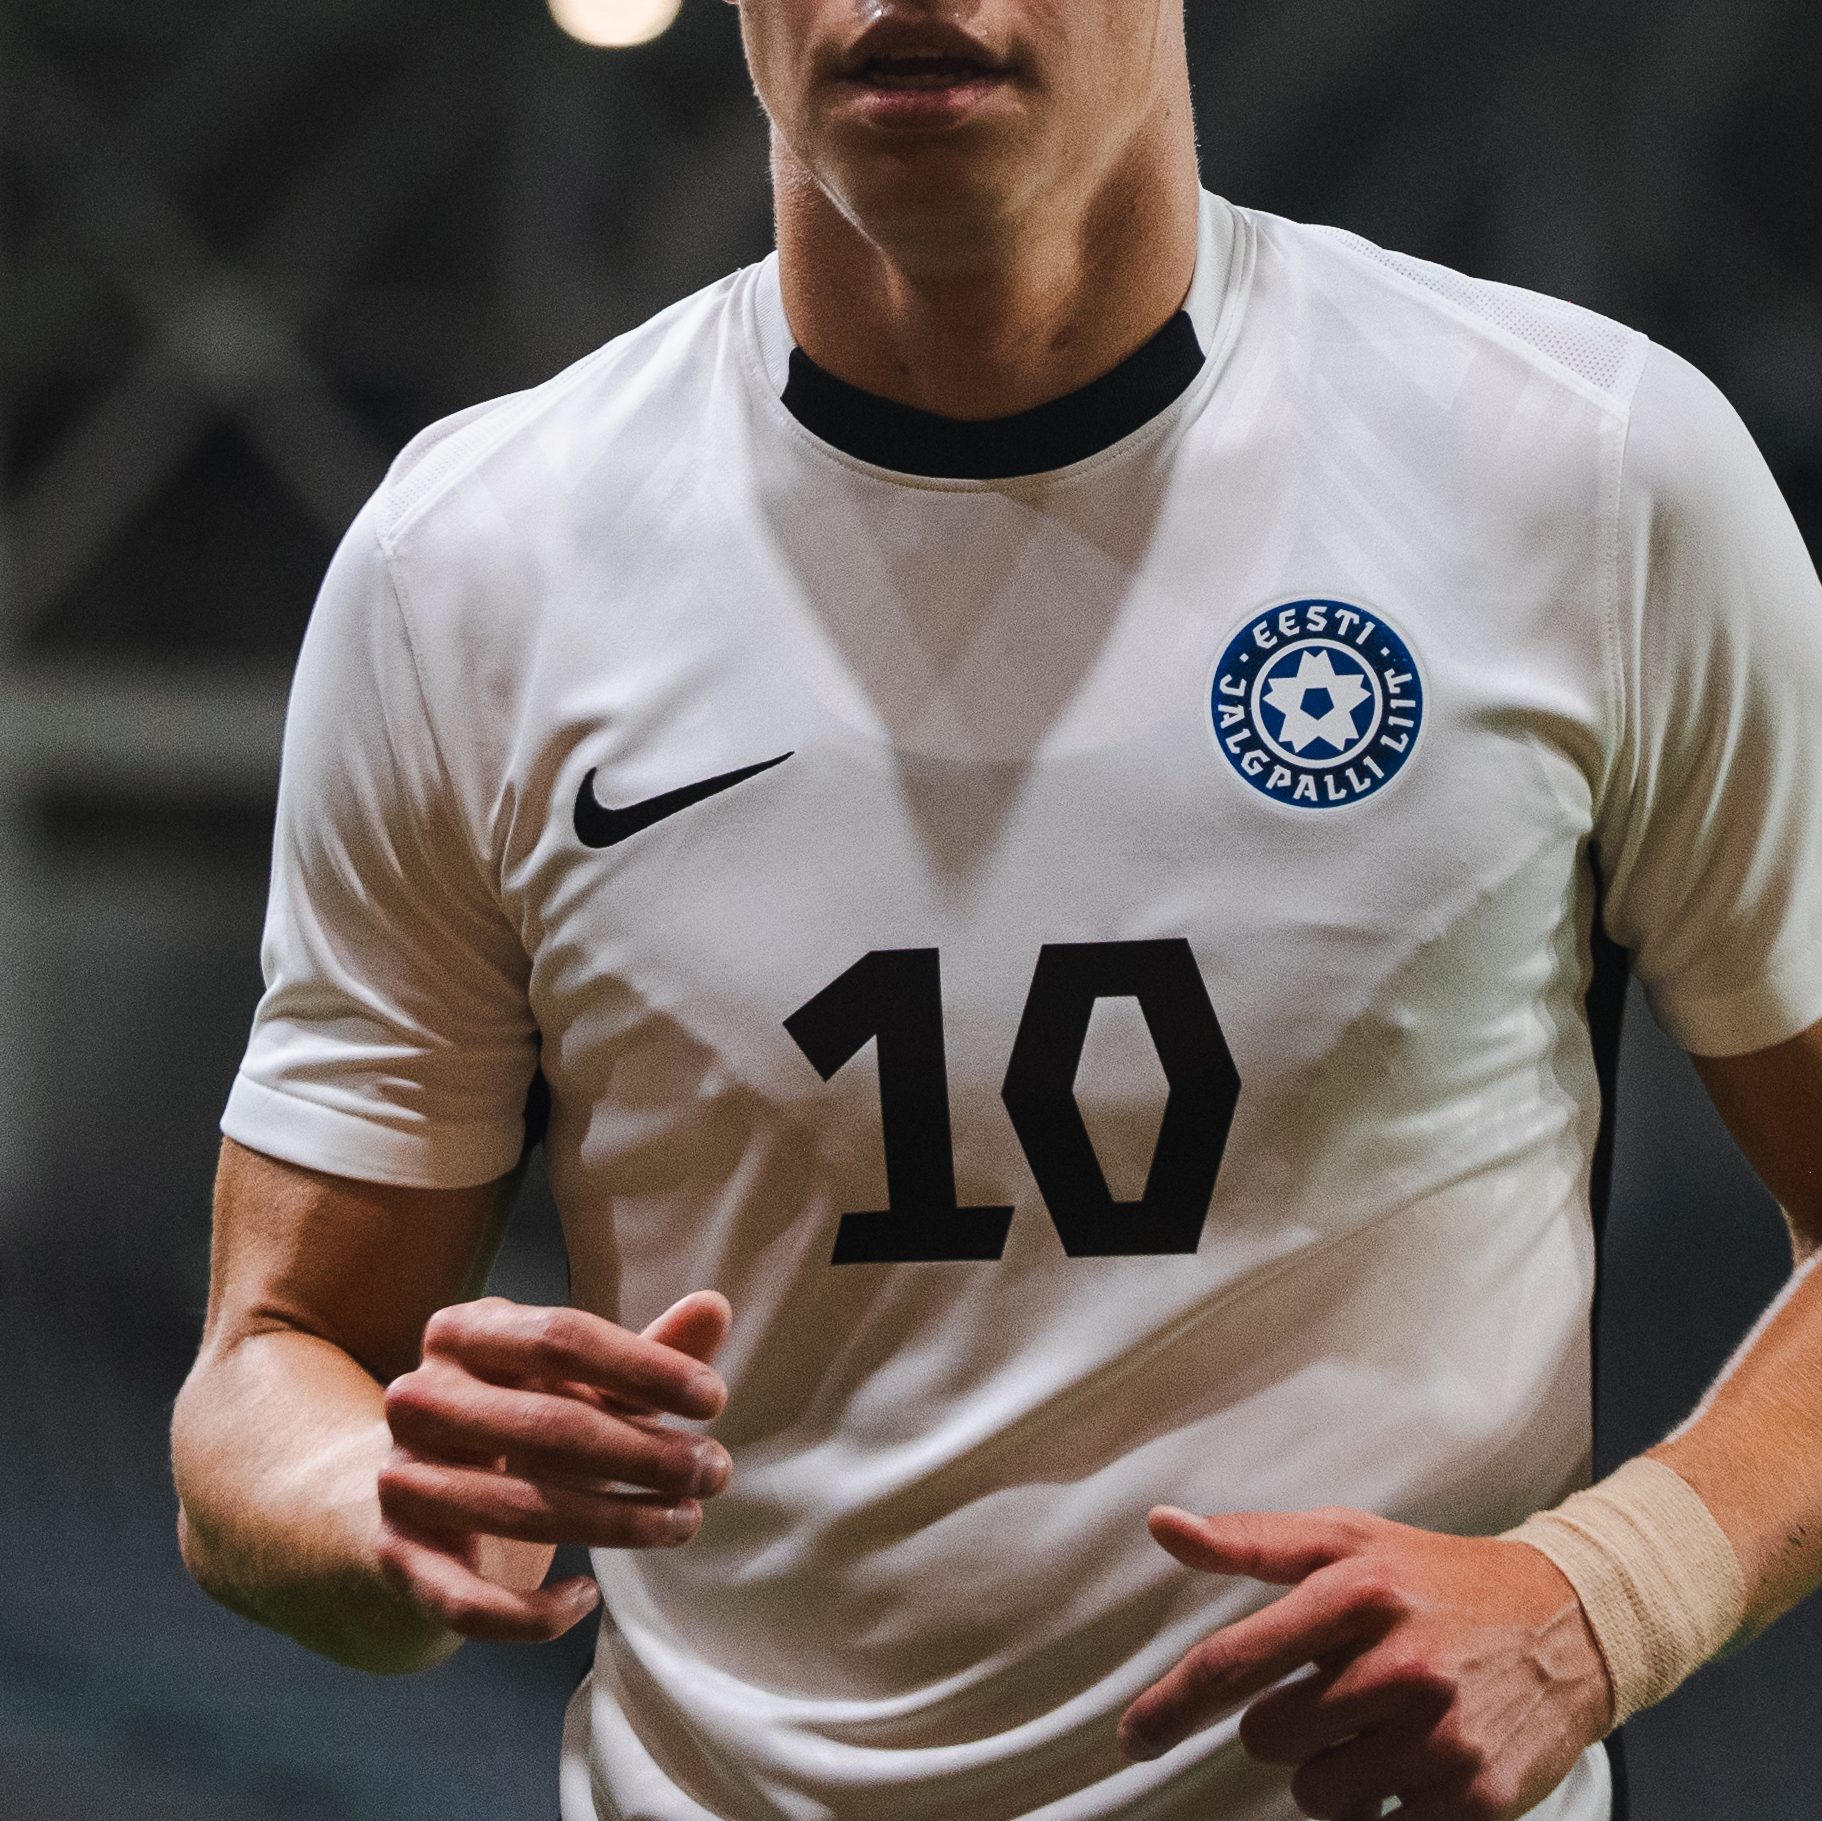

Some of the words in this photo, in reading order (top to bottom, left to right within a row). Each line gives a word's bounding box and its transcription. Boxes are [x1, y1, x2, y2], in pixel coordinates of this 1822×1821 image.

[1253, 606, 1376, 649] EESTI
[1218, 674, 1385, 801] JALGPALLI
[1380, 668, 1416, 753] LIIT
[782, 937, 1242, 1265] 10
